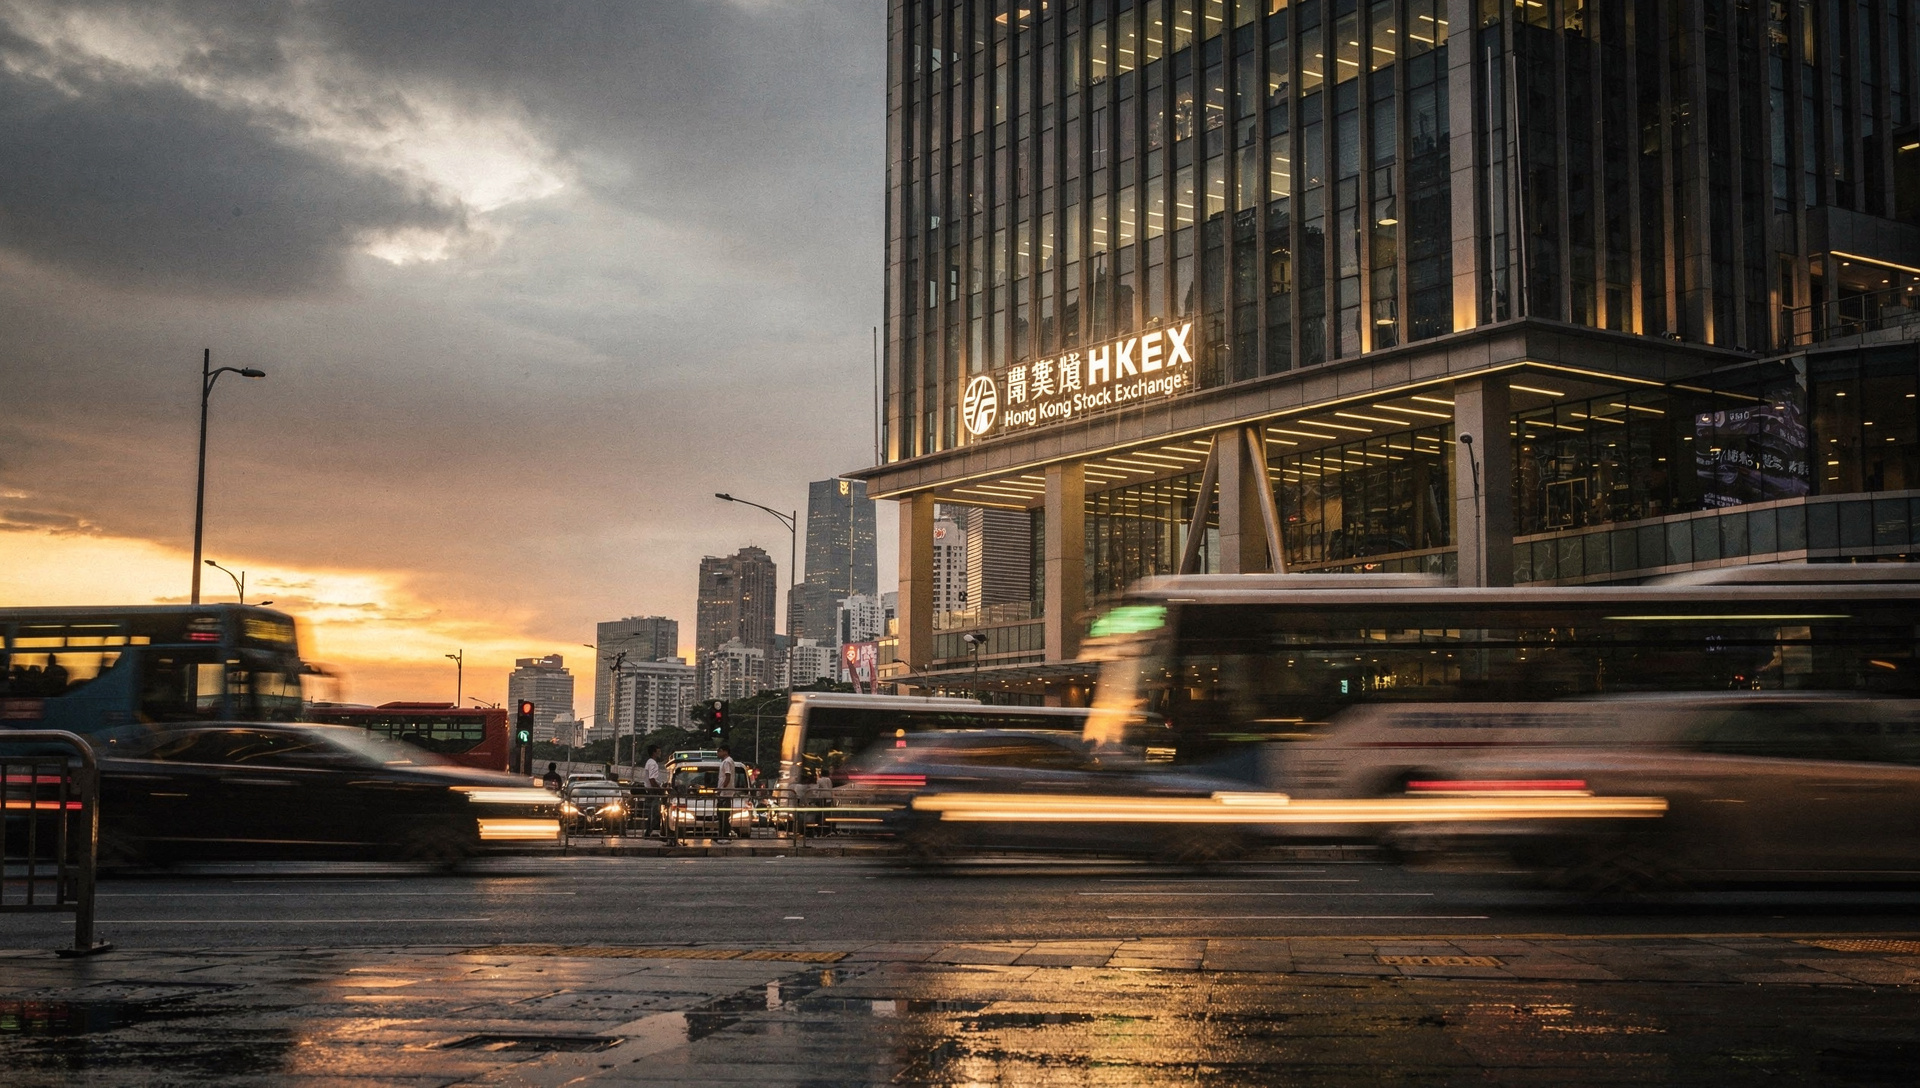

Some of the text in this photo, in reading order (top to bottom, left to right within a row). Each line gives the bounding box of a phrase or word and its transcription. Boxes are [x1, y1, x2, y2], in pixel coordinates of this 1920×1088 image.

[1088, 323, 1192, 385] HKEX
[1005, 374, 1182, 427] Hong Kong Stock Exchange
